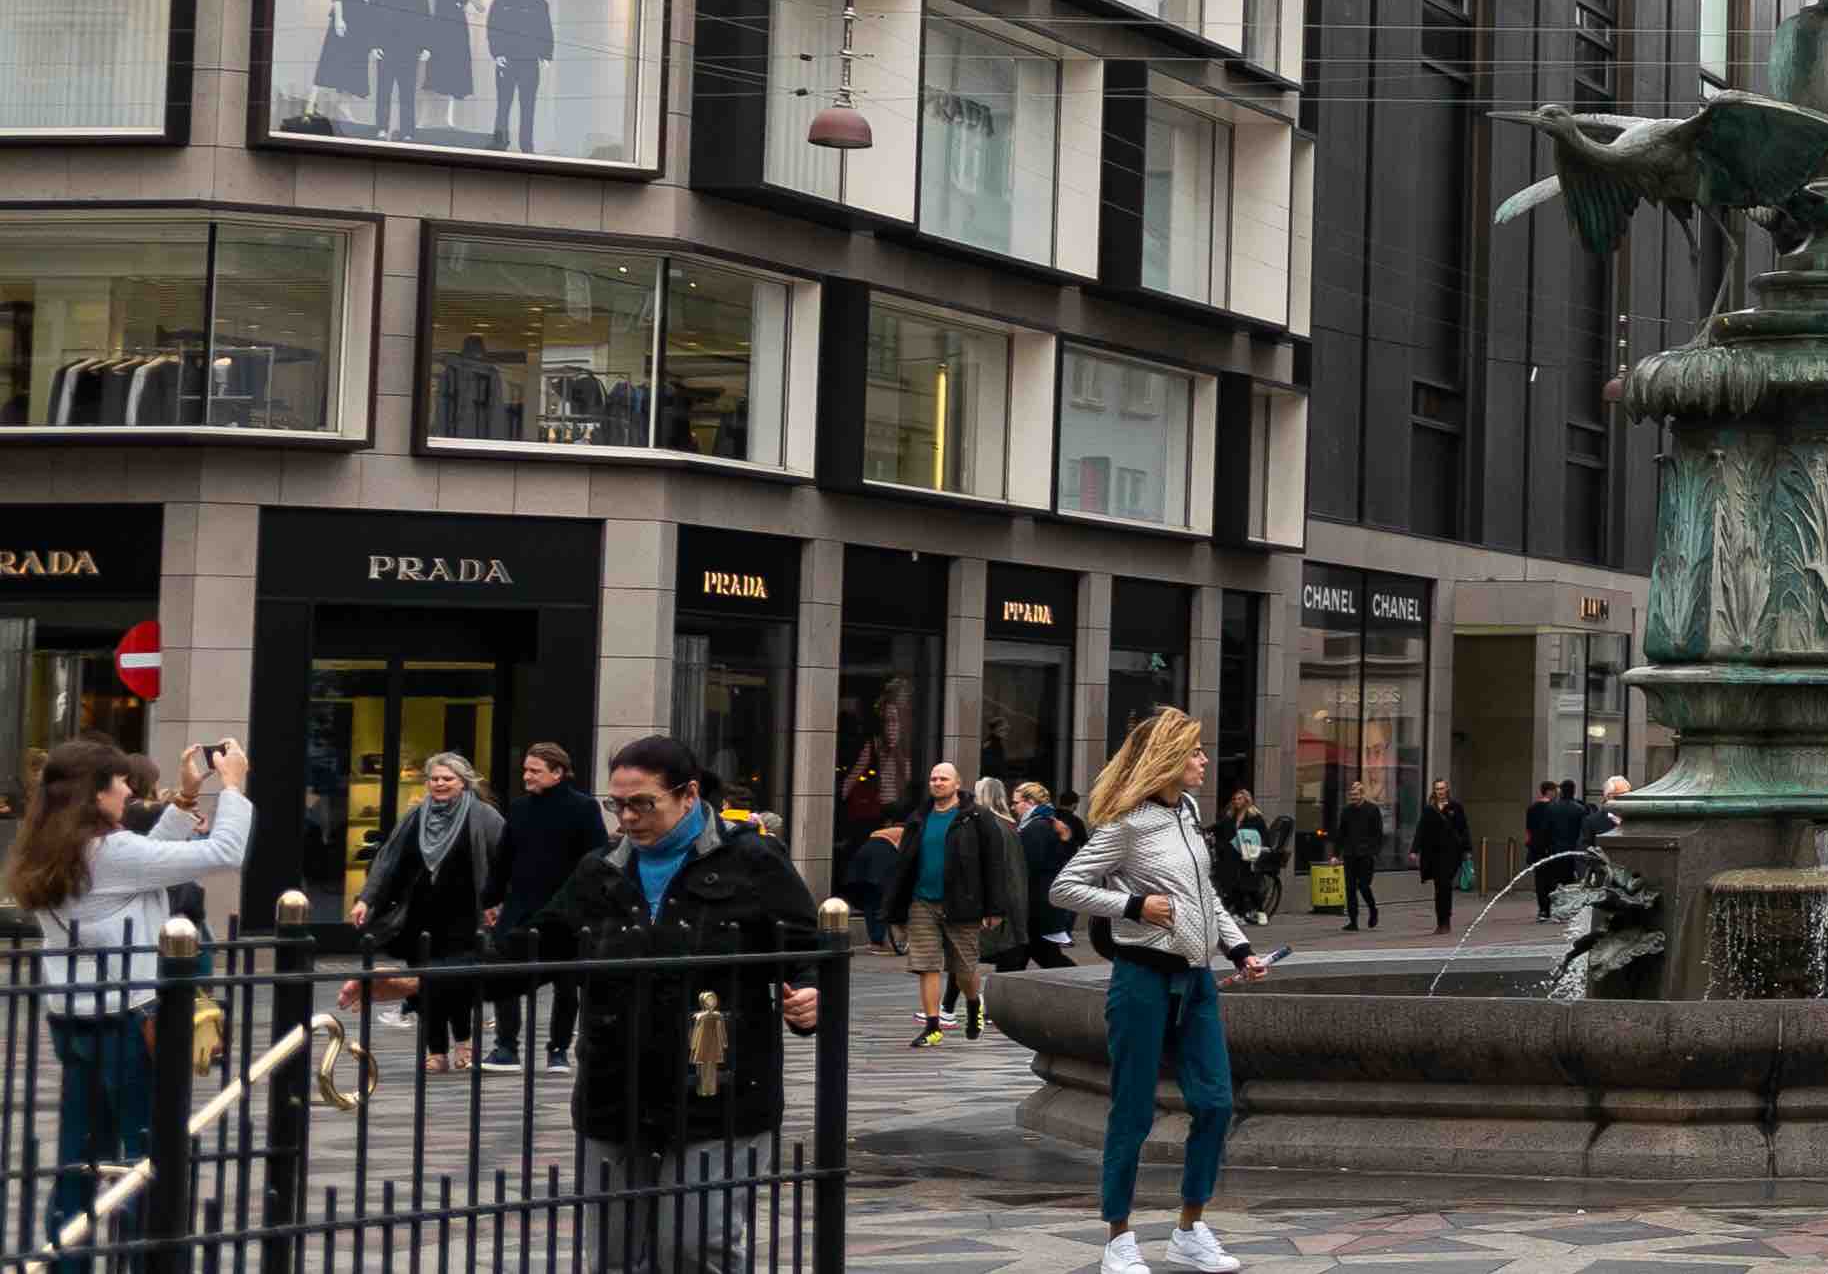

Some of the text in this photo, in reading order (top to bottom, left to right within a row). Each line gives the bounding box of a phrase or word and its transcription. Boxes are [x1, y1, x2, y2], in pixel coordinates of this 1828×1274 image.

[367, 555, 514, 584] PRADA
[703, 571, 769, 598] PRADA
[1303, 584, 1356, 614] CHANEL
[1372, 593, 1422, 622] CHANEL
